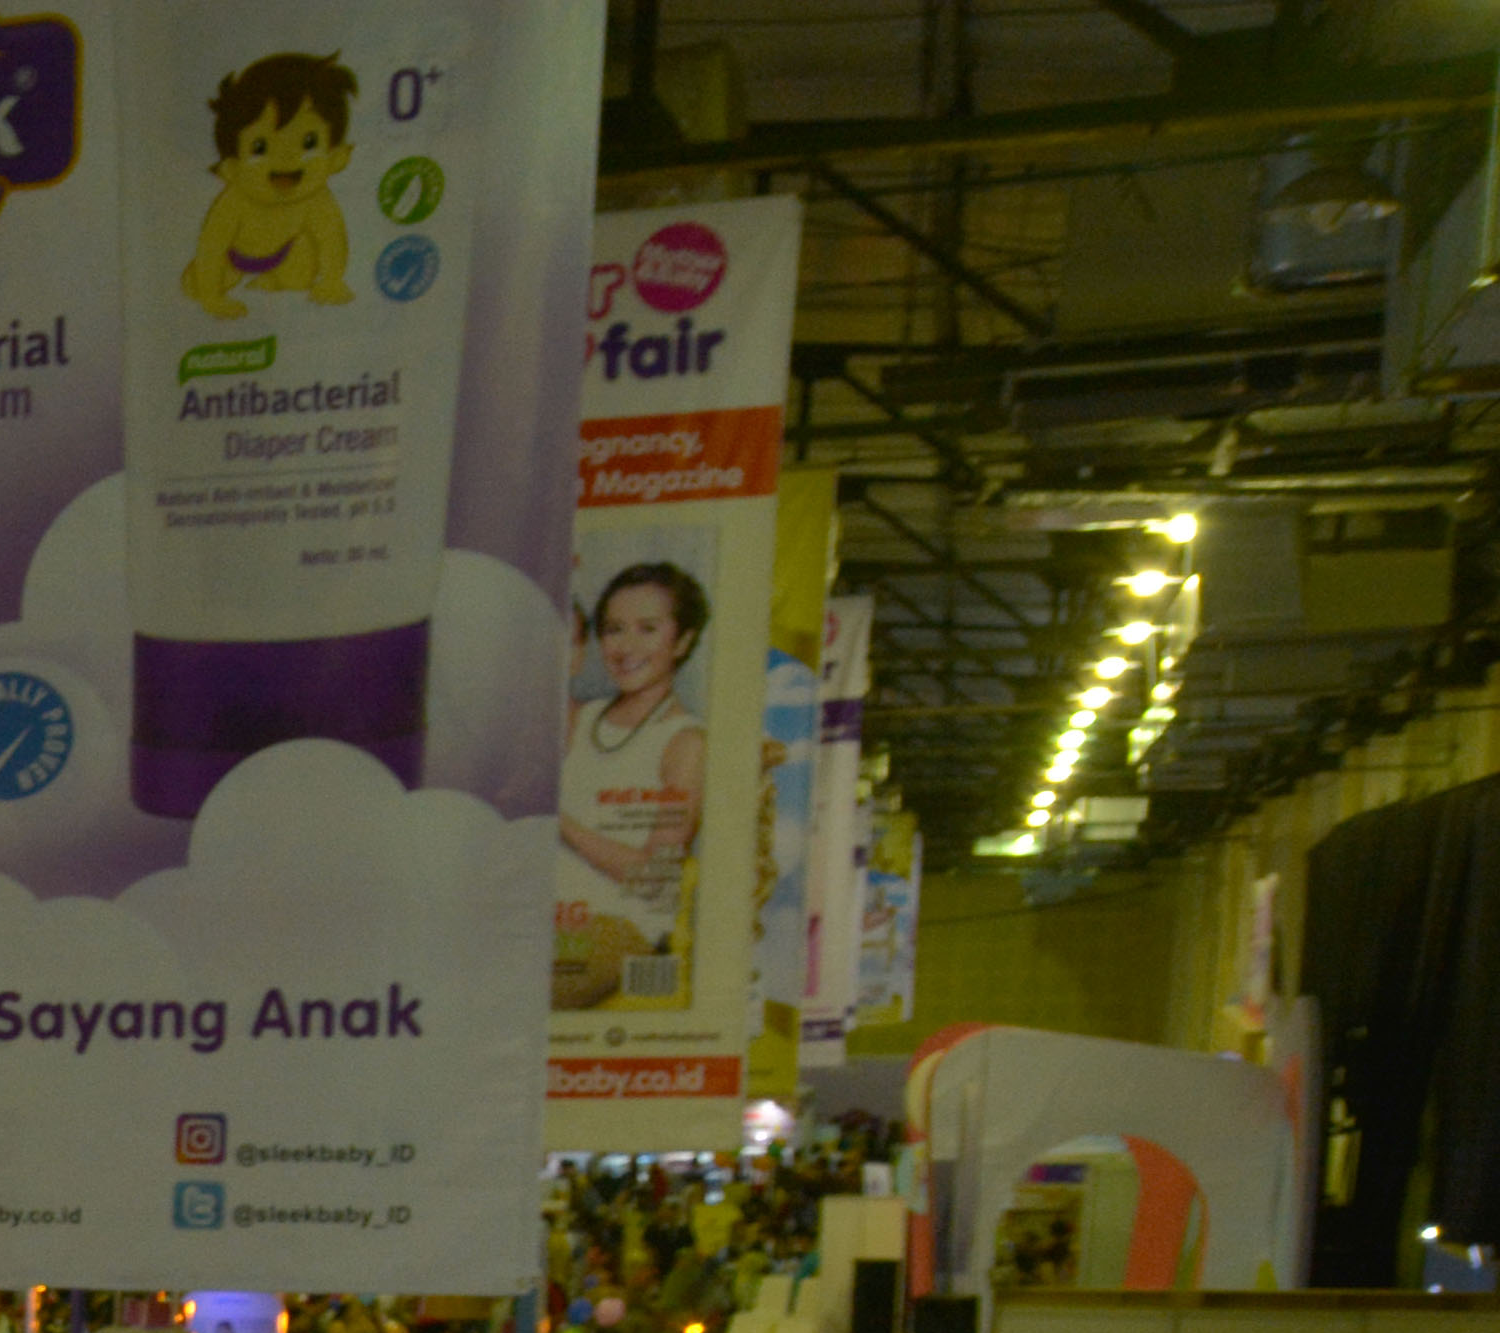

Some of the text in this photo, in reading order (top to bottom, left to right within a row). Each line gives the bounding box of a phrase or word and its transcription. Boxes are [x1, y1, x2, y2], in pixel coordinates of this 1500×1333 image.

[600, 317, 724, 380] fair
[179, 370, 399, 420] Antibacterial
[225, 426, 397, 461] Diaper Cream
[593, 461, 744, 499] Magazine
[15, 695, 73, 794] PROVEN
[251, 983, 422, 1039] Anak
[236, 1143, 415, 1168] @sleekbaby_ID
[234, 1204, 412, 1229] @sleekbaby_ID
